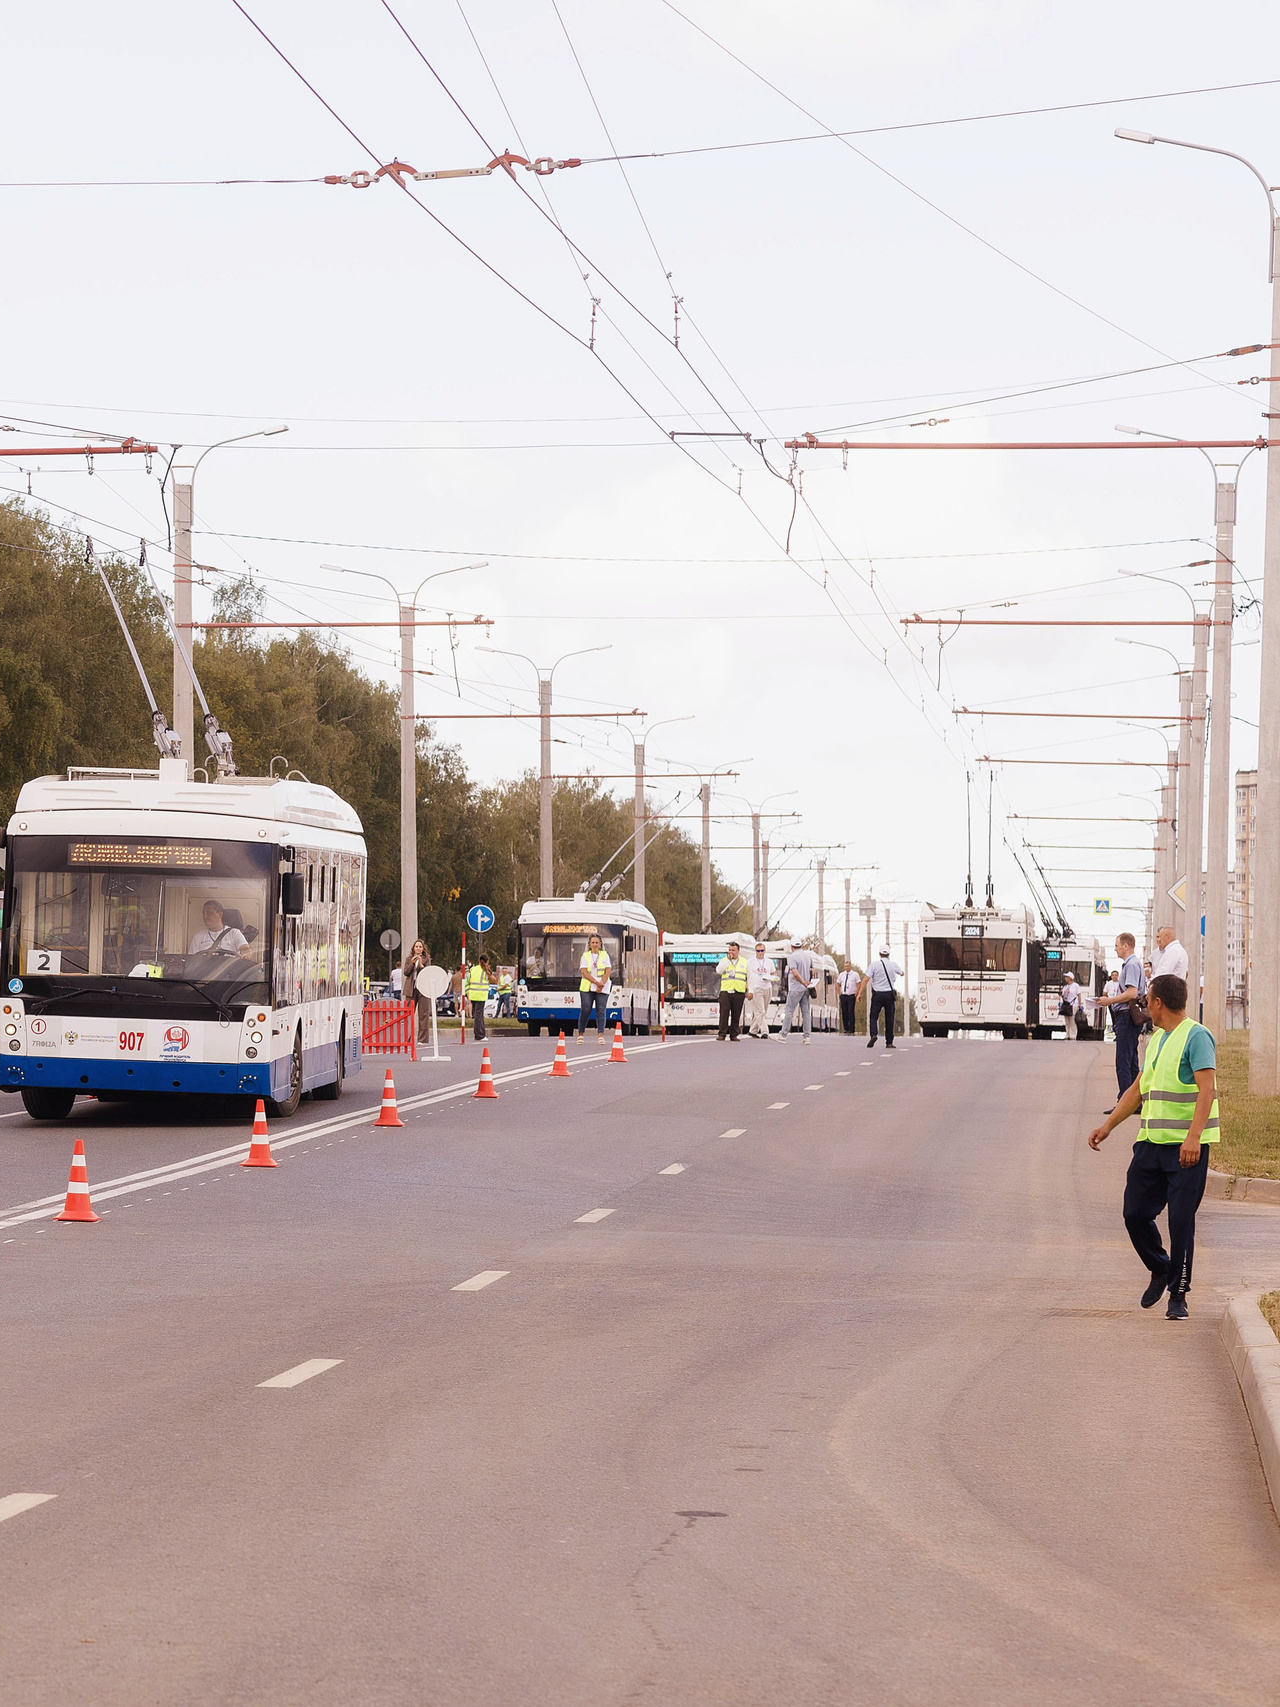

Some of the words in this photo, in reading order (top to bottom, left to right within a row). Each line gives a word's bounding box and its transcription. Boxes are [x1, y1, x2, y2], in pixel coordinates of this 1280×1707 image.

[964, 926, 980, 935] 2024
[37, 953, 51, 971] 2
[563, 996, 575, 1004] 904
[119, 1031, 145, 1051] 907
